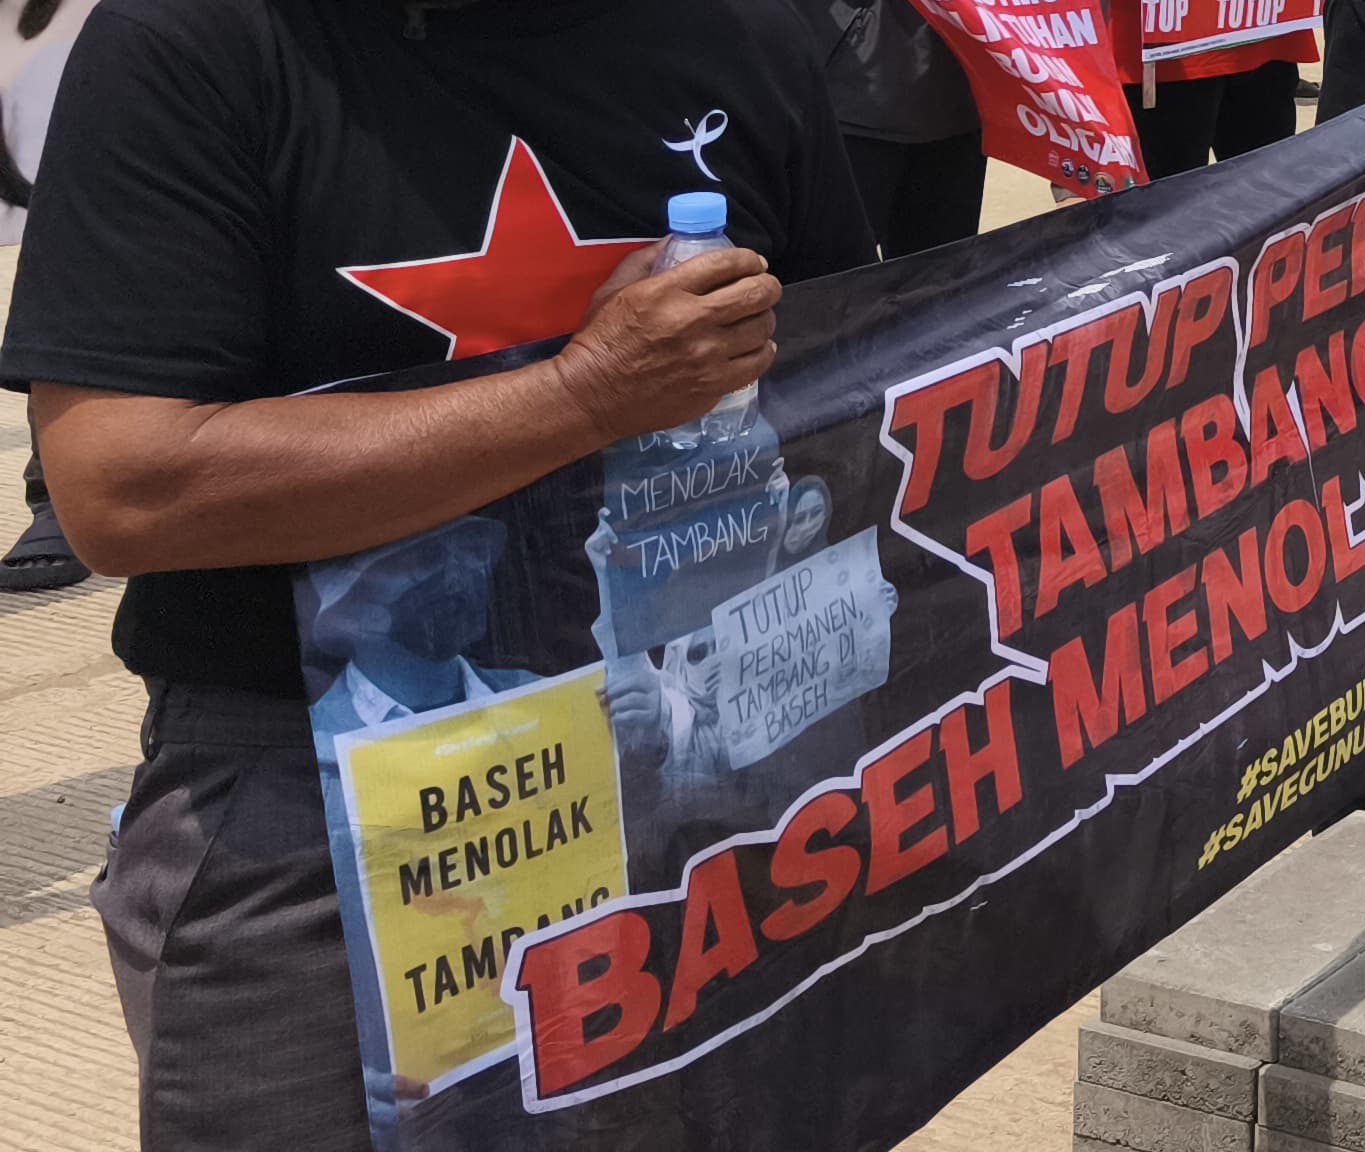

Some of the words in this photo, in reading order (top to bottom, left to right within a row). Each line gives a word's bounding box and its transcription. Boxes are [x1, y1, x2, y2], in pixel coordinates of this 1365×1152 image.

[890, 266, 1232, 516] TUTUP
[621, 446, 760, 520] MENOLAK
[626, 502, 768, 578] TAMBANG
[729, 568, 813, 644] TUTUP
[740, 592, 864, 686] PERMANEN,
[728, 645, 830, 723] TAMBANG
[839, 628, 855, 666] DI
[765, 679, 828, 744] BASEH
[419, 743, 566, 833] BASEH
[399, 796, 593, 906] MENOLAK
[516, 680, 1023, 1098] BASEH
